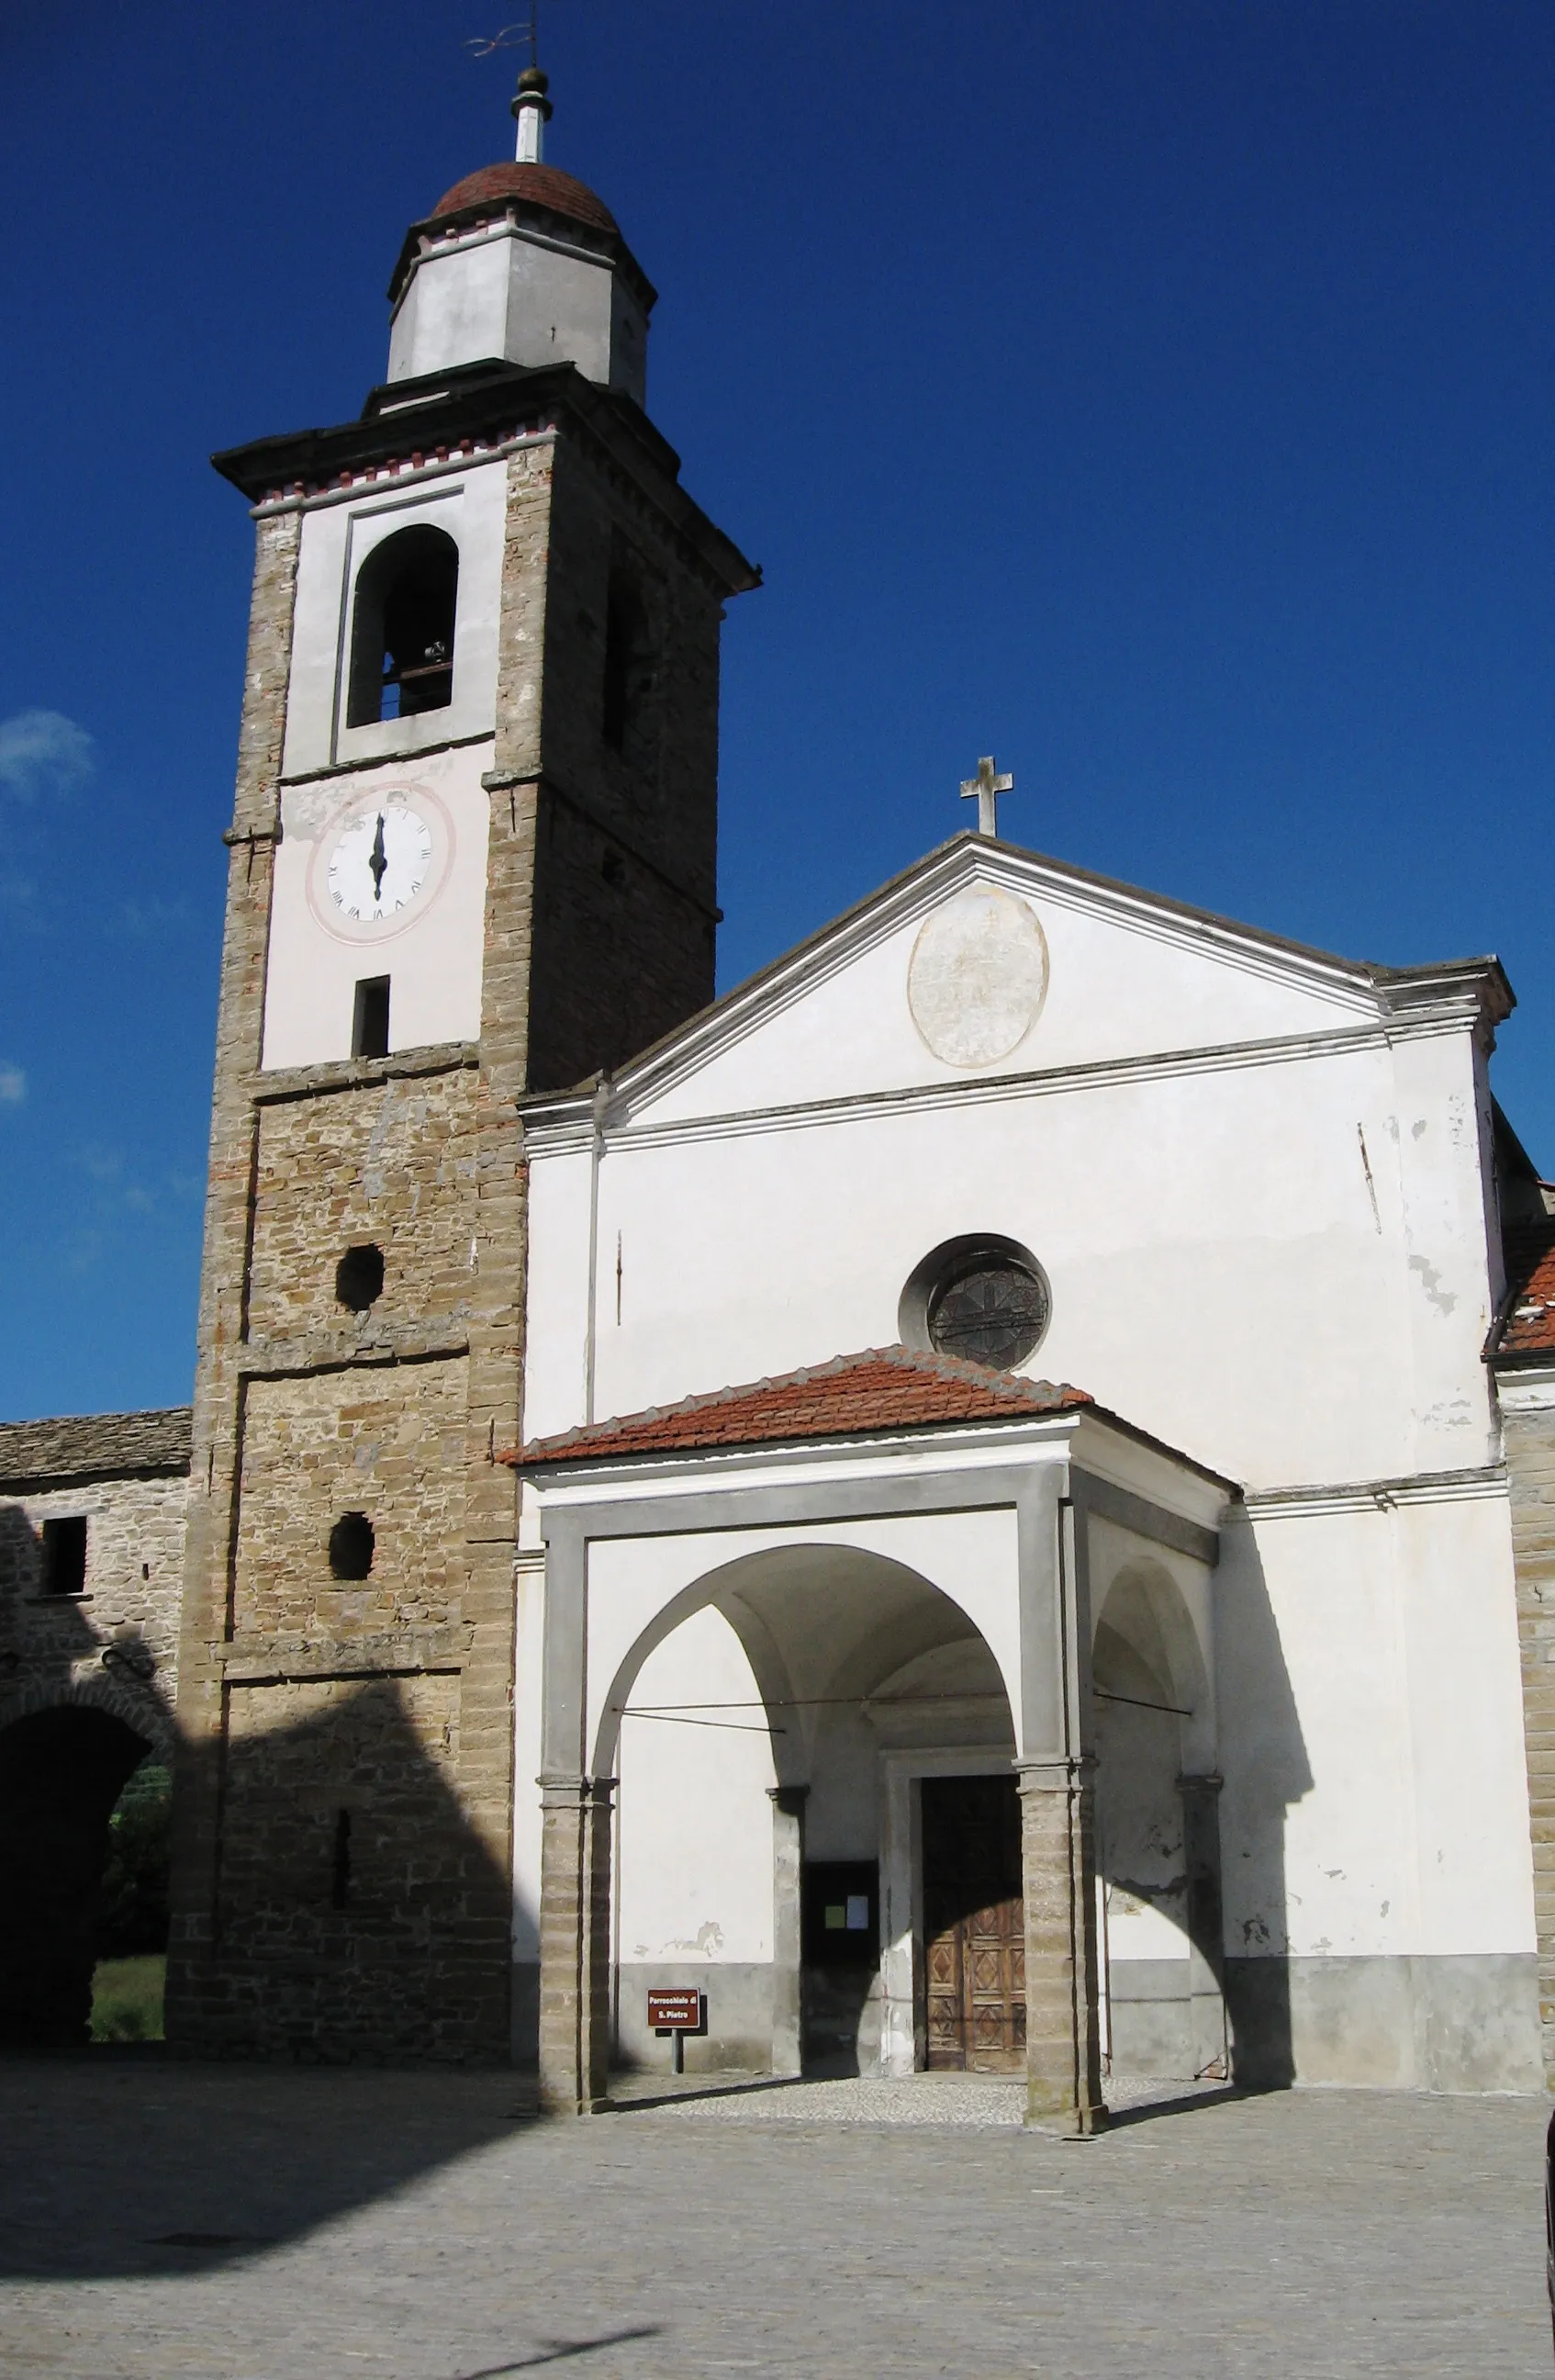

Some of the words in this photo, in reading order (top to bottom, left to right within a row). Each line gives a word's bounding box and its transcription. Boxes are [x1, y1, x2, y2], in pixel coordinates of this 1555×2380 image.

[420, 848, 431, 859] III
[395, 899, 405, 911] V
[347, 906, 360, 919] VII
[373, 908, 383, 920] VI
[689, 1995, 697, 2004] di
[658, 2010, 666, 2019] S.
[666, 2010, 688, 2019] Pietro
